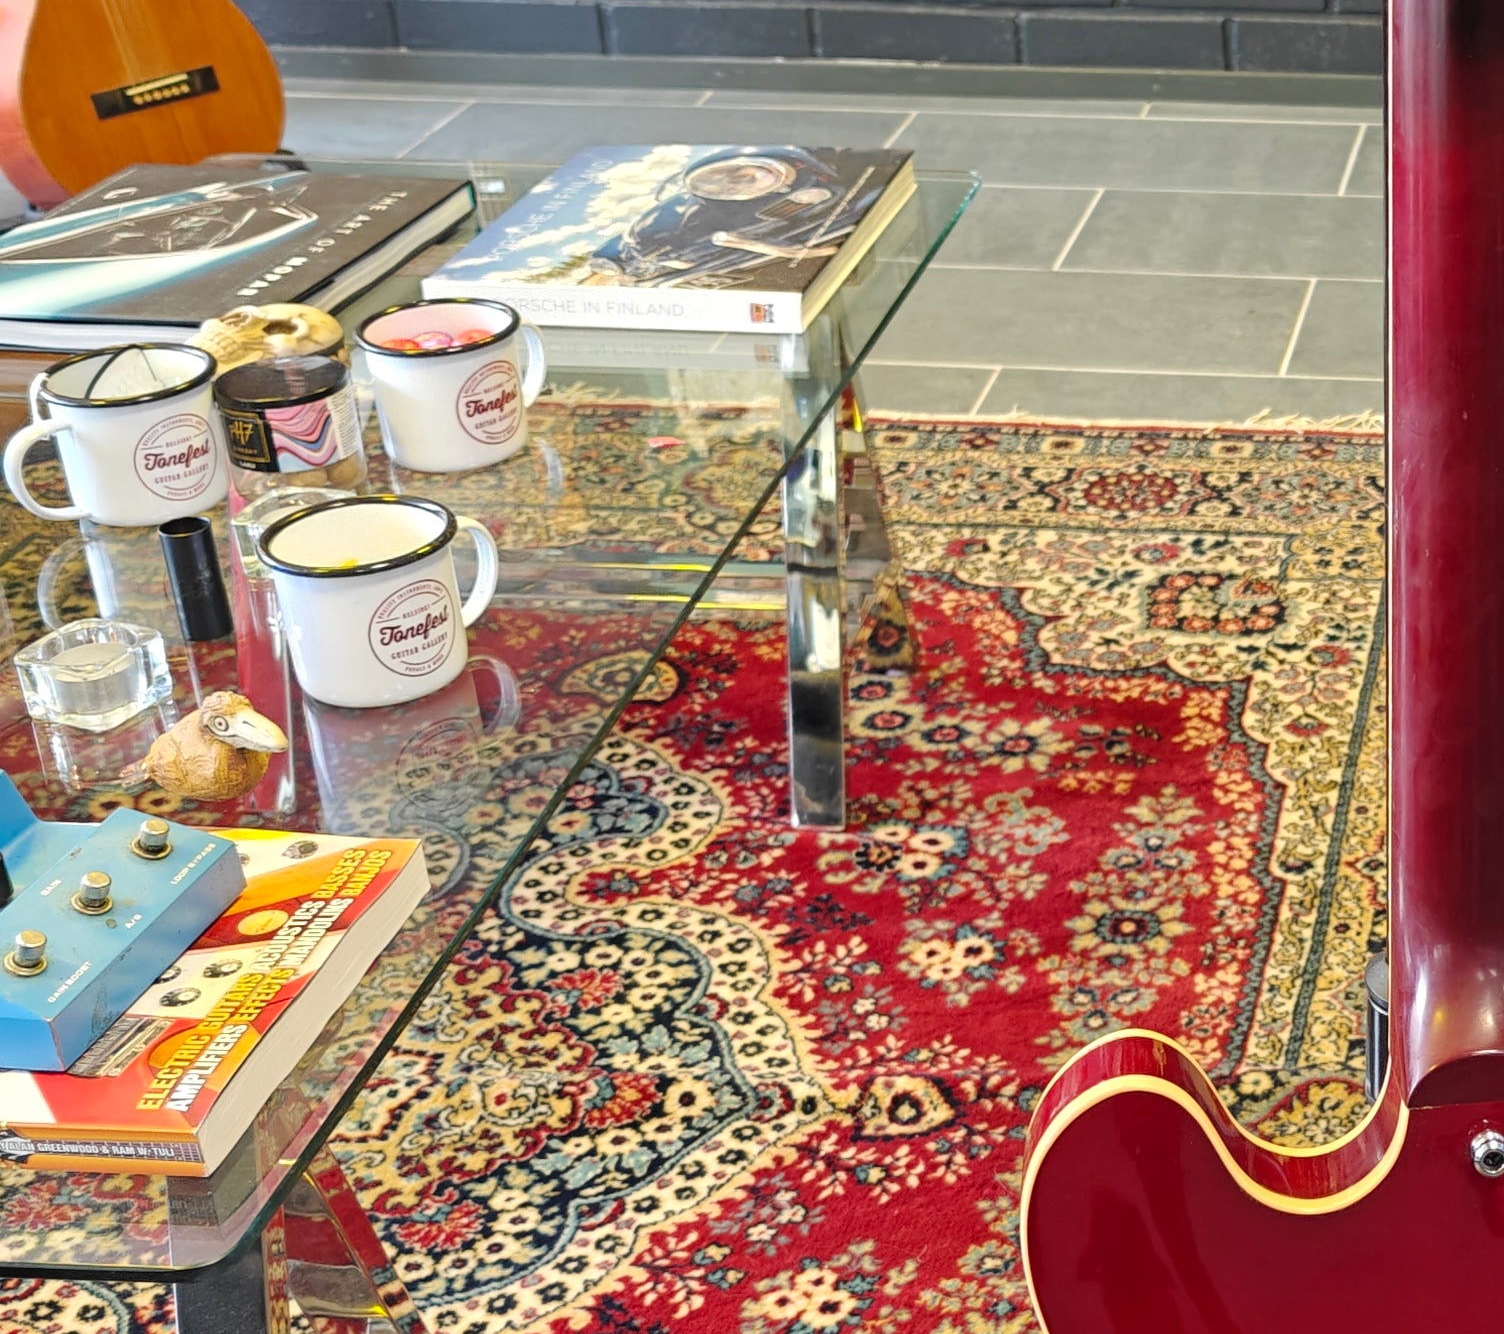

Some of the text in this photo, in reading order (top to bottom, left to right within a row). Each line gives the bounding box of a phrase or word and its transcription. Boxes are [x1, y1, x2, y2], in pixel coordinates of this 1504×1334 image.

[236, 191, 408, 296] THE ART OF MOPAR
[583, 300, 600, 314] IN
[606, 301, 685, 317] FINLAND
[144, 438, 210, 471] Tonefest
[154, 463, 209, 484] GUITAR GALLERY
[379, 604, 449, 646] Tonefest
[402, 604, 431, 619] HELSINKI
[391, 632, 448, 660] GUITAR GALLERY
[170, 843, 217, 885] LOOP BYPASS
[40, 879, 62, 896] GAIN
[47, 960, 93, 1003] GAIN BOOST
[136, 848, 366, 1110] ELECTRIC GUITARS ACOUSTICS BASSES
[165, 850, 392, 1112] AMPLIFIERS EFFECTS MANDOLINS BANJOS
[8, 1140, 35, 1152] ALAN
[37, 1142, 99, 1155] GREENWOOD
[102, 1145, 110, 1155] &
[112, 1145, 135, 1156] RAM
[152, 1147, 175, 1157] TULI
